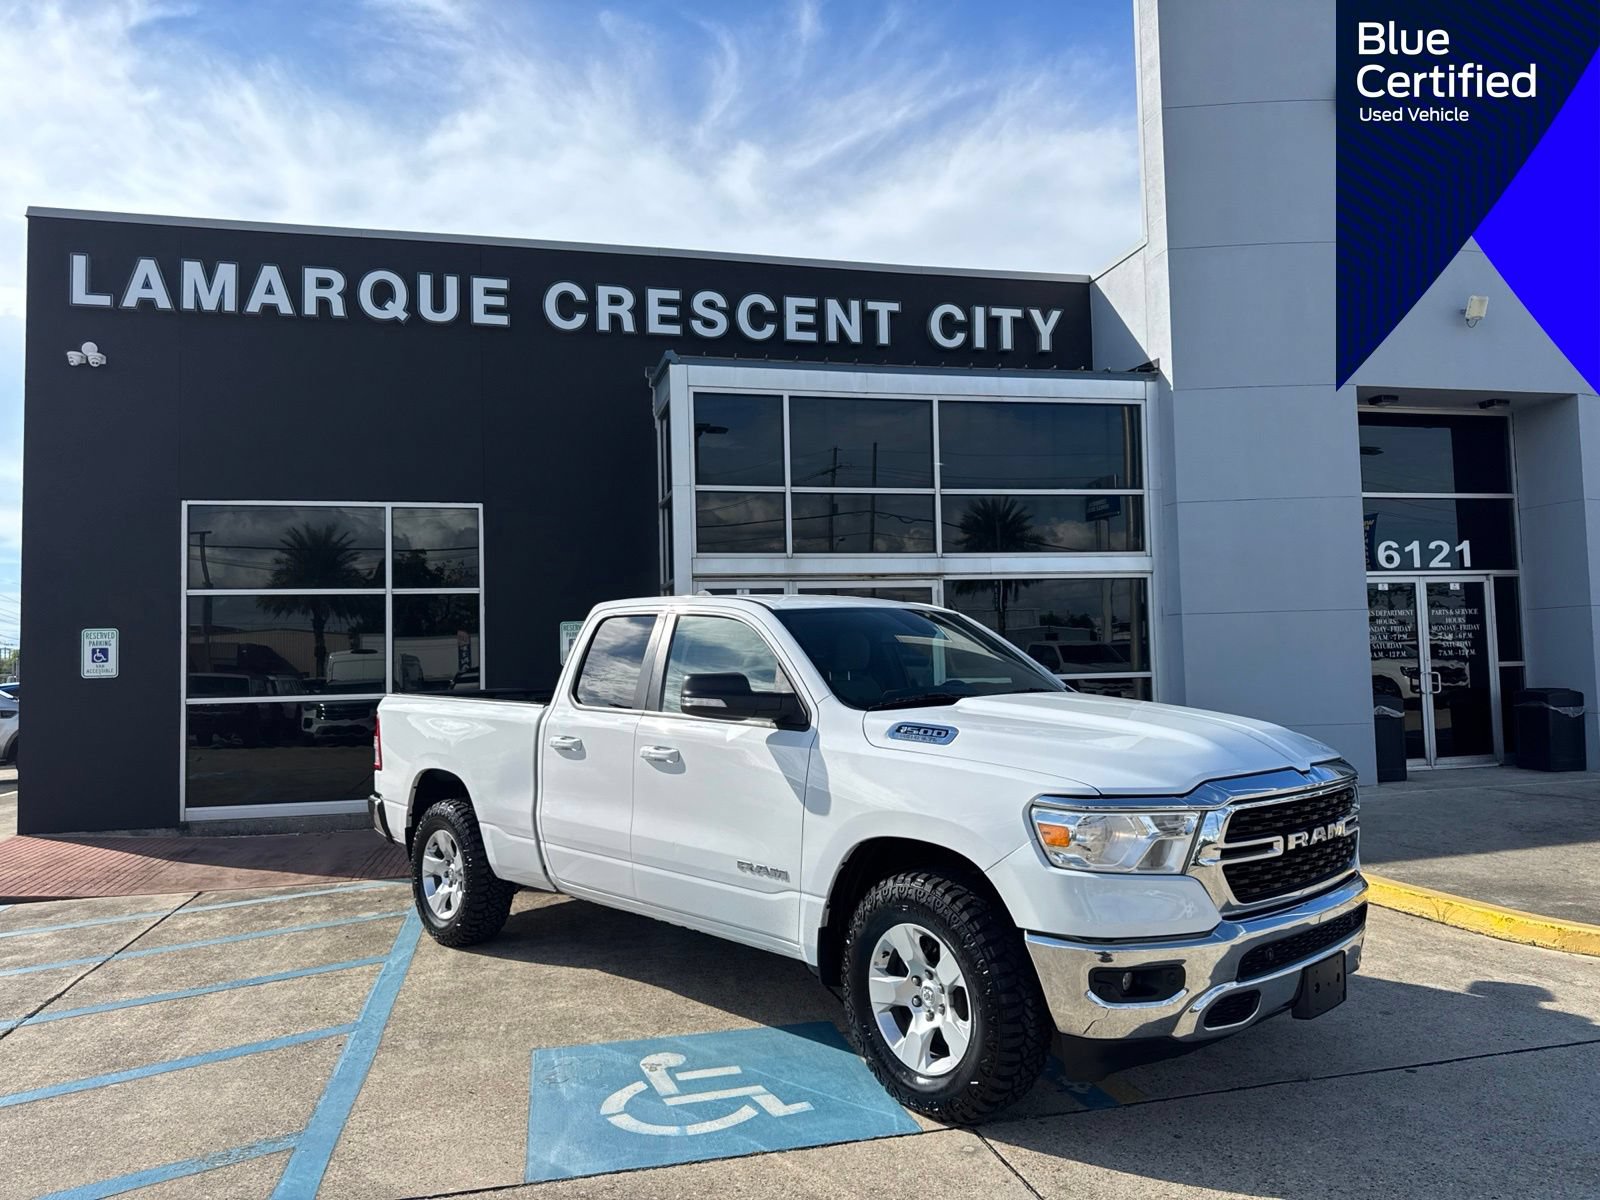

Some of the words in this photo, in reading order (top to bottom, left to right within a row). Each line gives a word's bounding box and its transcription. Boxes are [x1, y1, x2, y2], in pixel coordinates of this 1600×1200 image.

[70, 253, 510, 326] LAMARQUE
[543, 281, 900, 346] CRESCENT
[928, 303, 1064, 352] CITY
[1377, 540, 1471, 569] 6121
[85, 631, 115, 640] RESERVED
[900, 726, 947, 737] 1500
[1287, 820, 1346, 850] RAM
